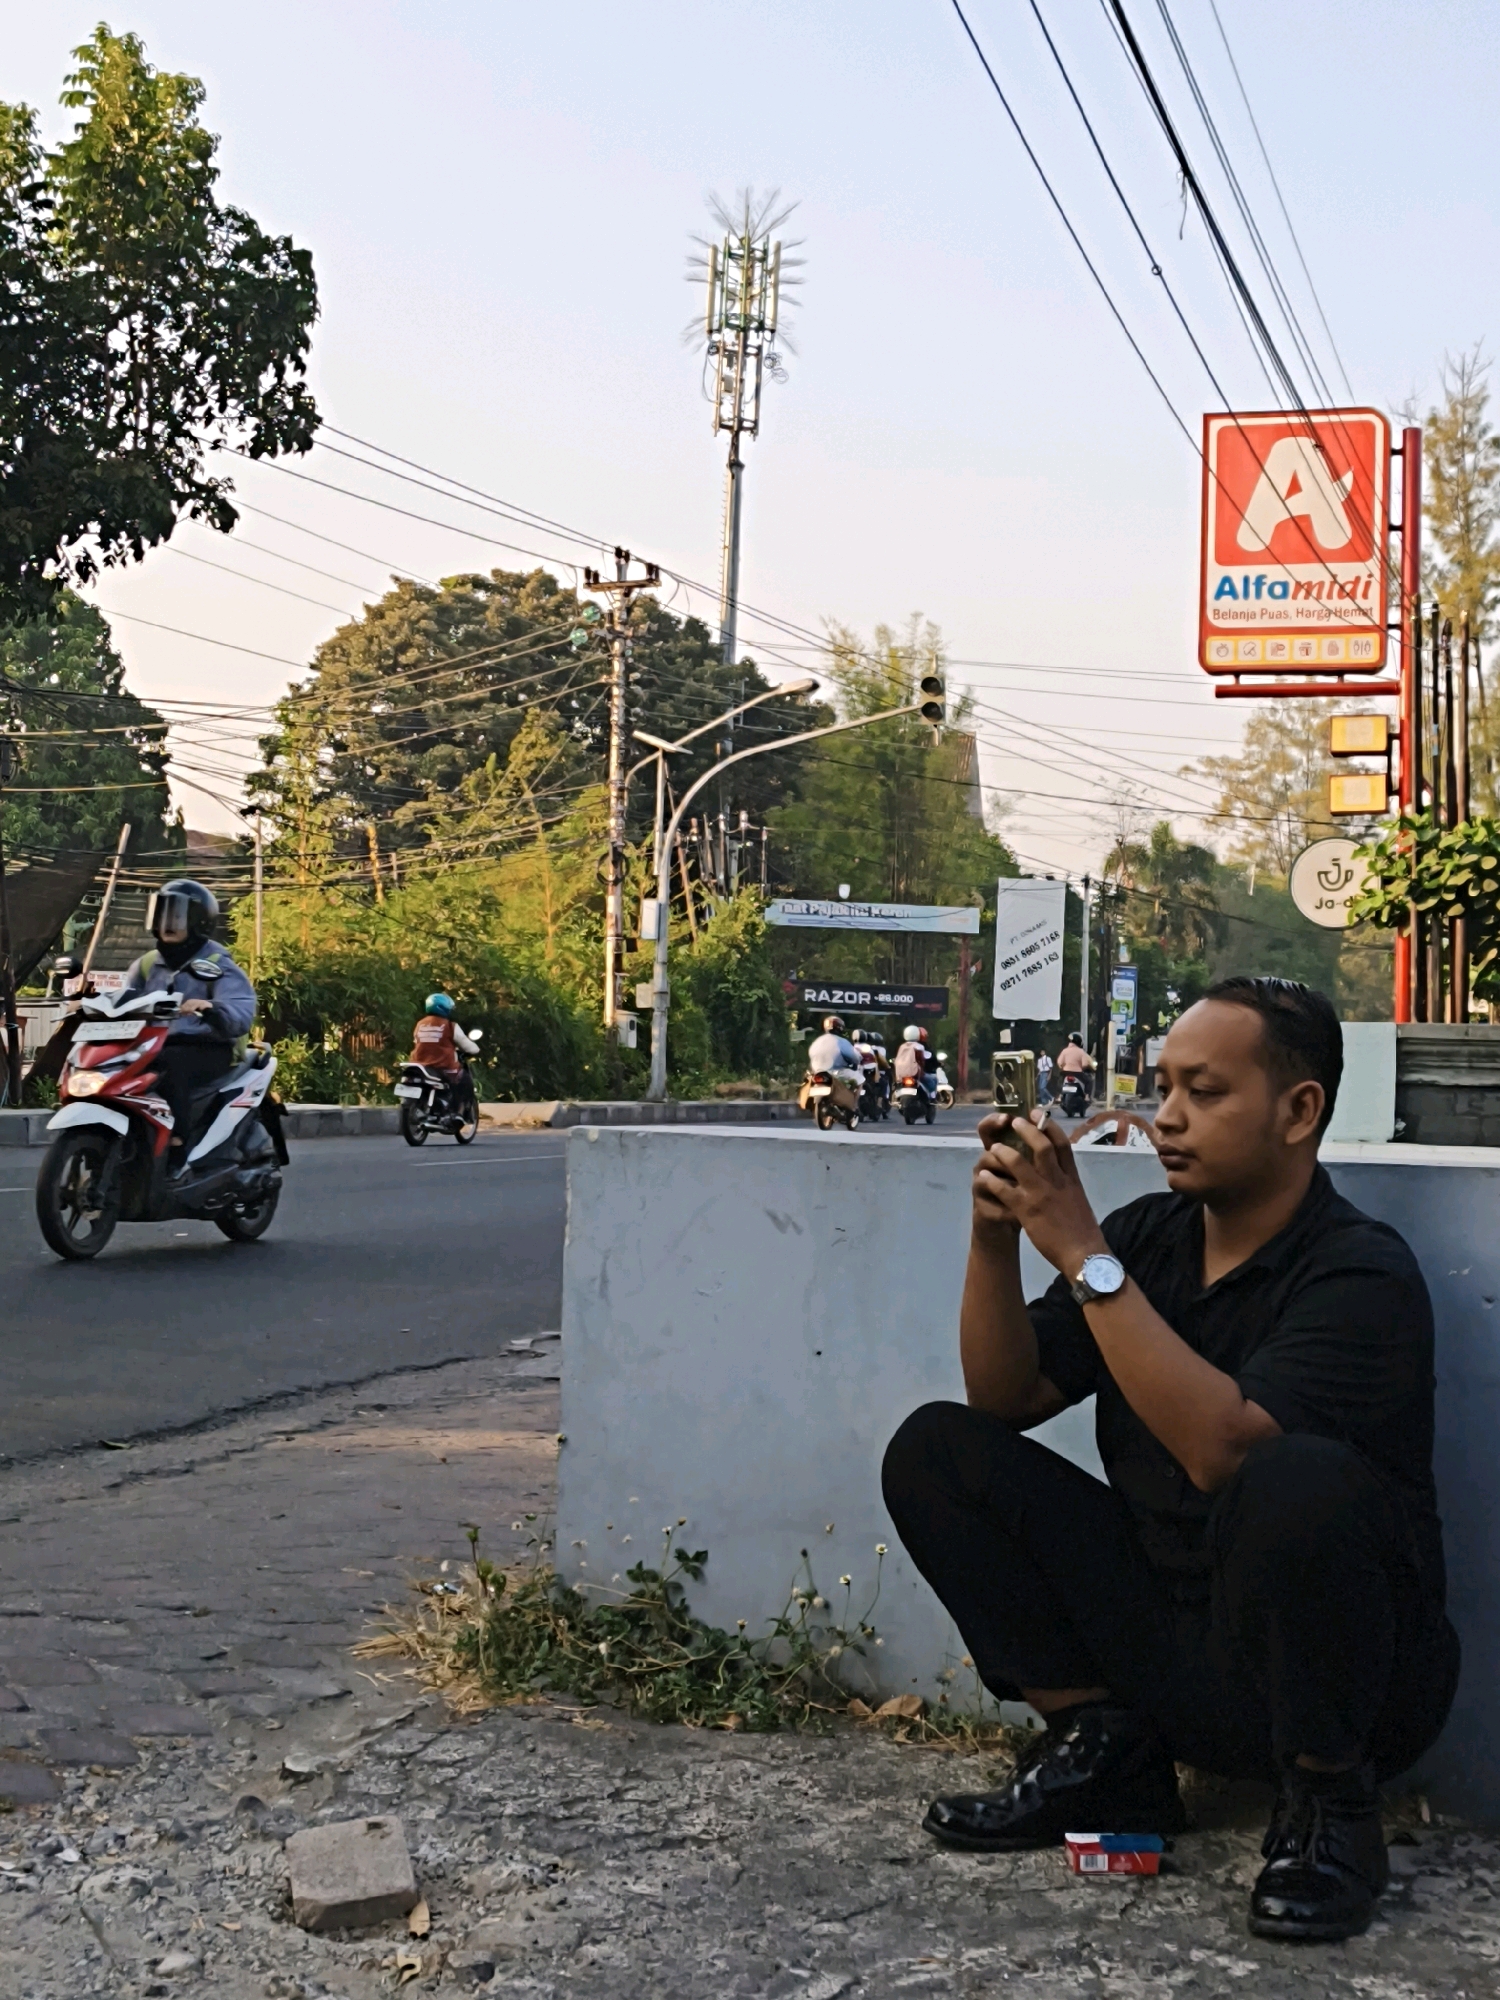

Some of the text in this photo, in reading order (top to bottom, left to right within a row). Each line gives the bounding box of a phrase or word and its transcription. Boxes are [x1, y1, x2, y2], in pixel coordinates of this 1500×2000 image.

[1213, 573, 1374, 601] Alfamidi
[1212, 606, 1374, 622] Belanja Puas, Harga Hemat
[1000, 973, 1022, 991] 0271
[804, 988, 871, 1005] RAZOR
